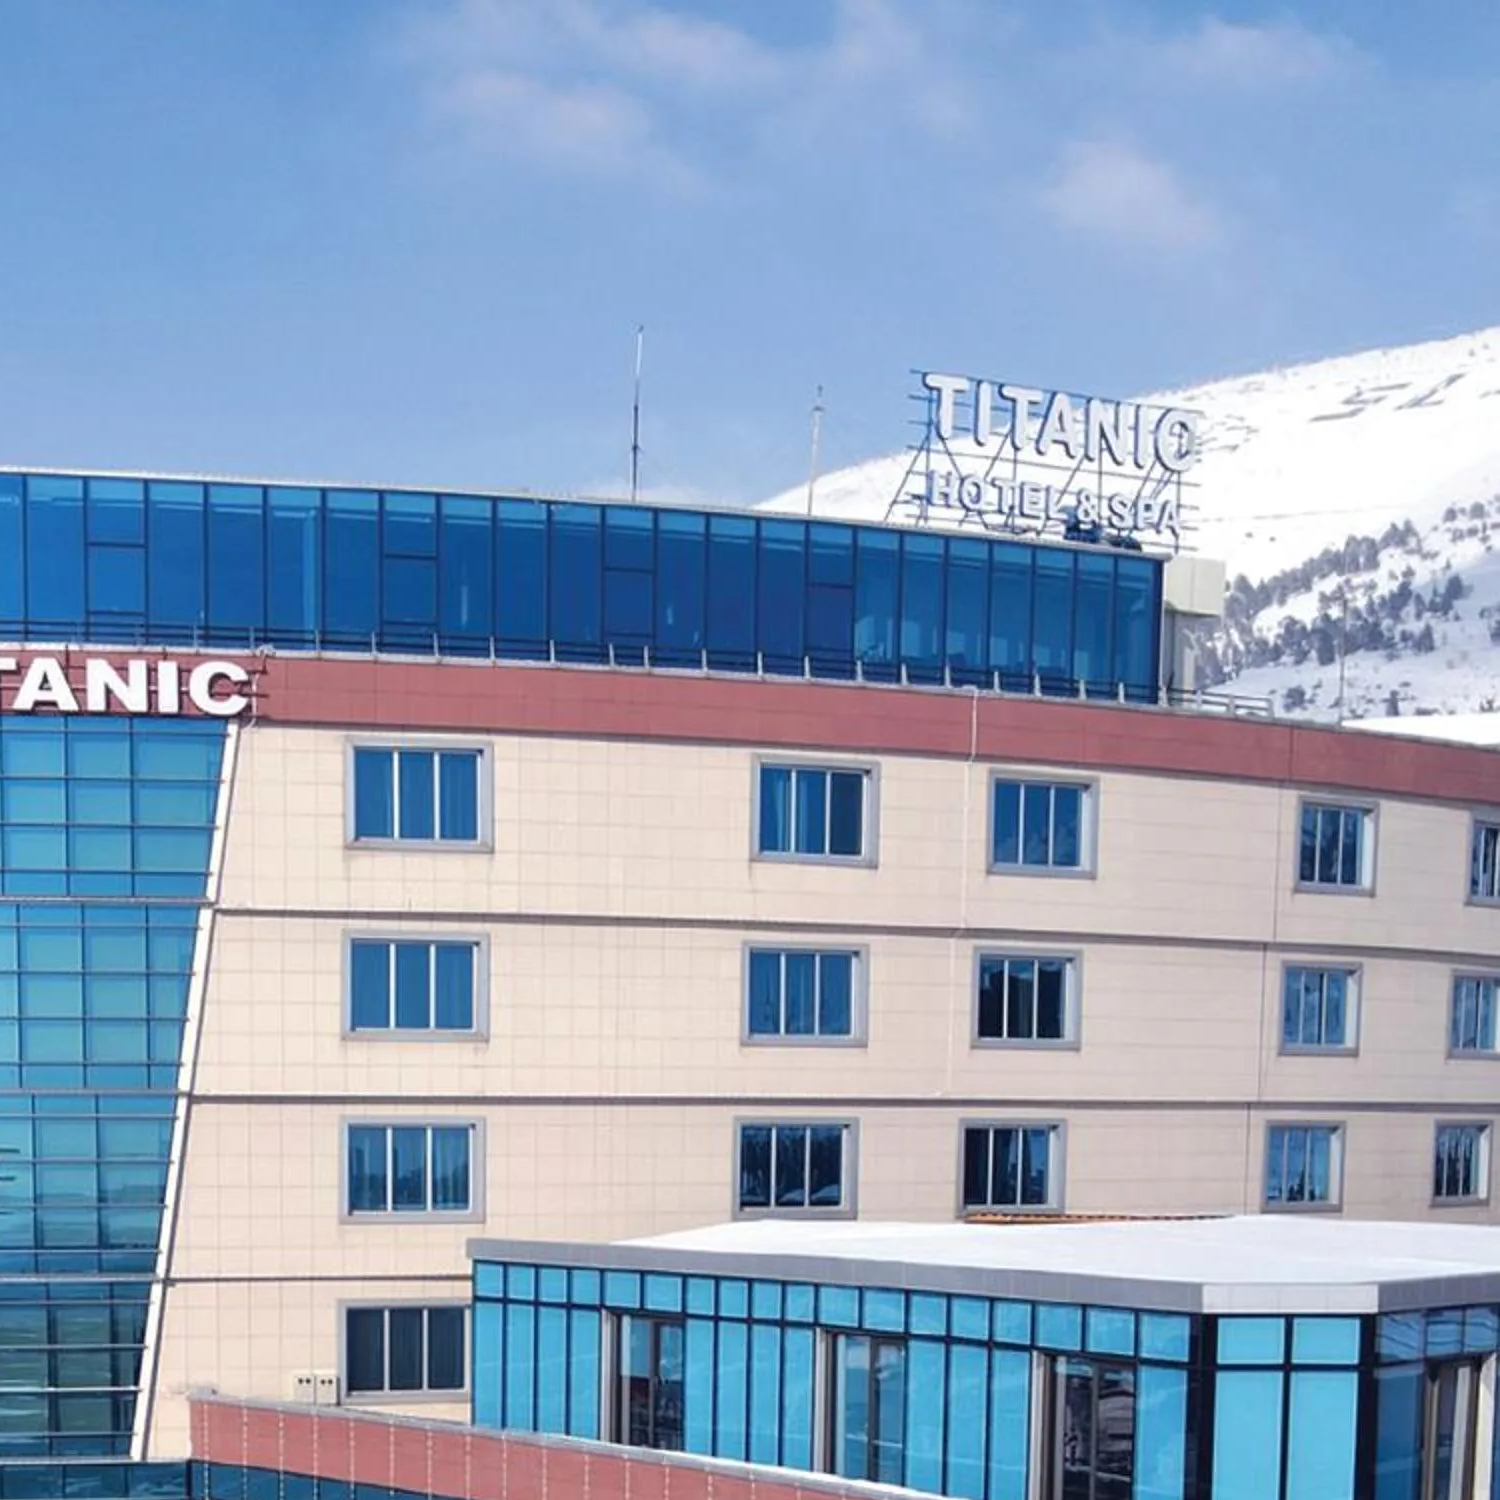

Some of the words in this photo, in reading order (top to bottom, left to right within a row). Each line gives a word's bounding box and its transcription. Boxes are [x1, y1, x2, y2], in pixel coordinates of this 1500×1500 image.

[922, 372, 1198, 473] TITANIC
[926, 469, 1066, 521] HOTEL
[1076, 487, 1099, 529] &
[1107, 492, 1182, 537] SPA
